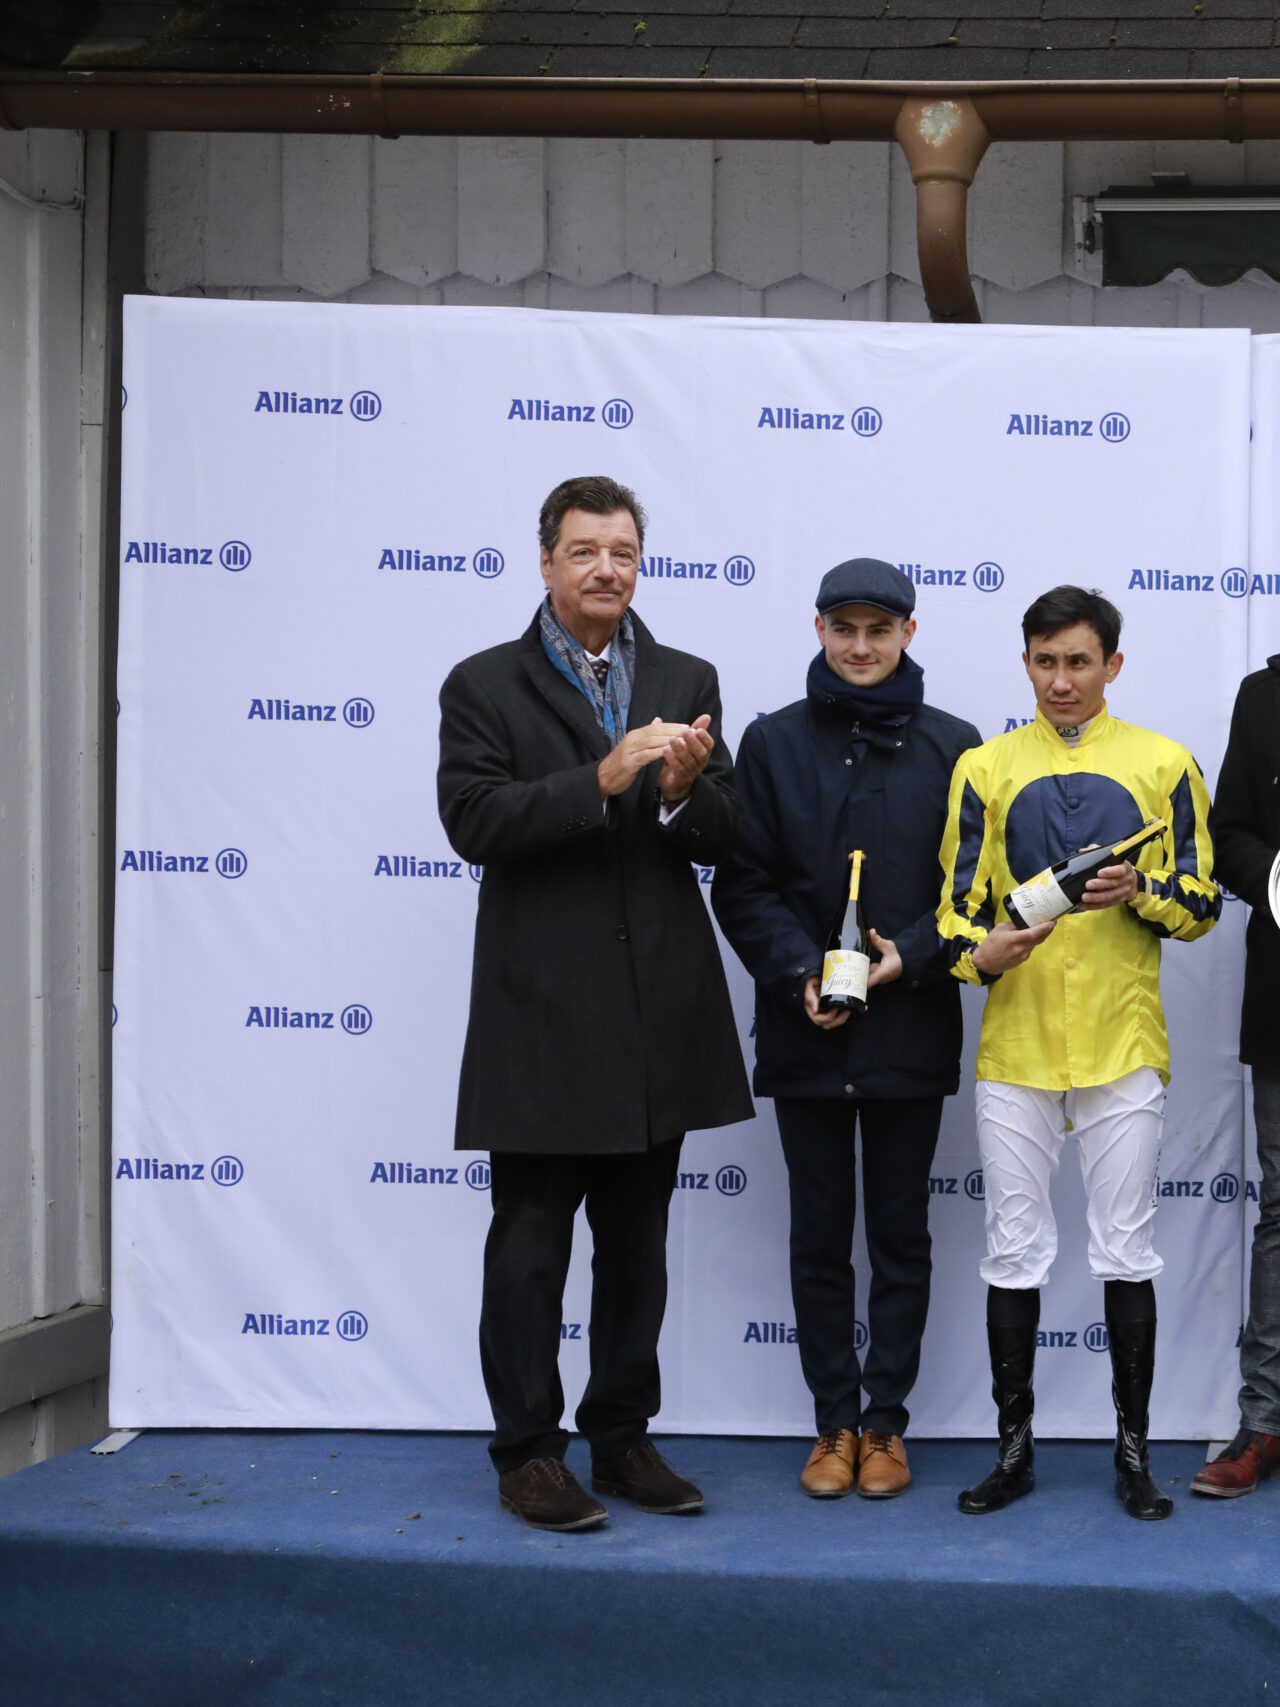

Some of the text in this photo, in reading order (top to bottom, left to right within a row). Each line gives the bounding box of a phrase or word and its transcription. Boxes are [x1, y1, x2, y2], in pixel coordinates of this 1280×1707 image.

[254, 390, 344, 415] Allianz
[507, 398, 596, 423] Allianz
[757, 407, 845, 431] Allianz
[1006, 413, 1093, 437] Allianz
[124, 541, 214, 566] Allianz
[378, 548, 467, 573] Allianz
[898, 564, 967, 586] lianz
[1127, 568, 1215, 592] Allianz
[247, 698, 337, 722] Allianz
[120, 849, 209, 873] Allianz
[373, 855, 463, 879] Allianz
[245, 1005, 335, 1029] Allianz
[115, 1157, 205, 1181] Allianz
[369, 1161, 459, 1185] Allianz
[241, 1312, 330, 1336] Allianz
[743, 1321, 799, 1344] Allia
